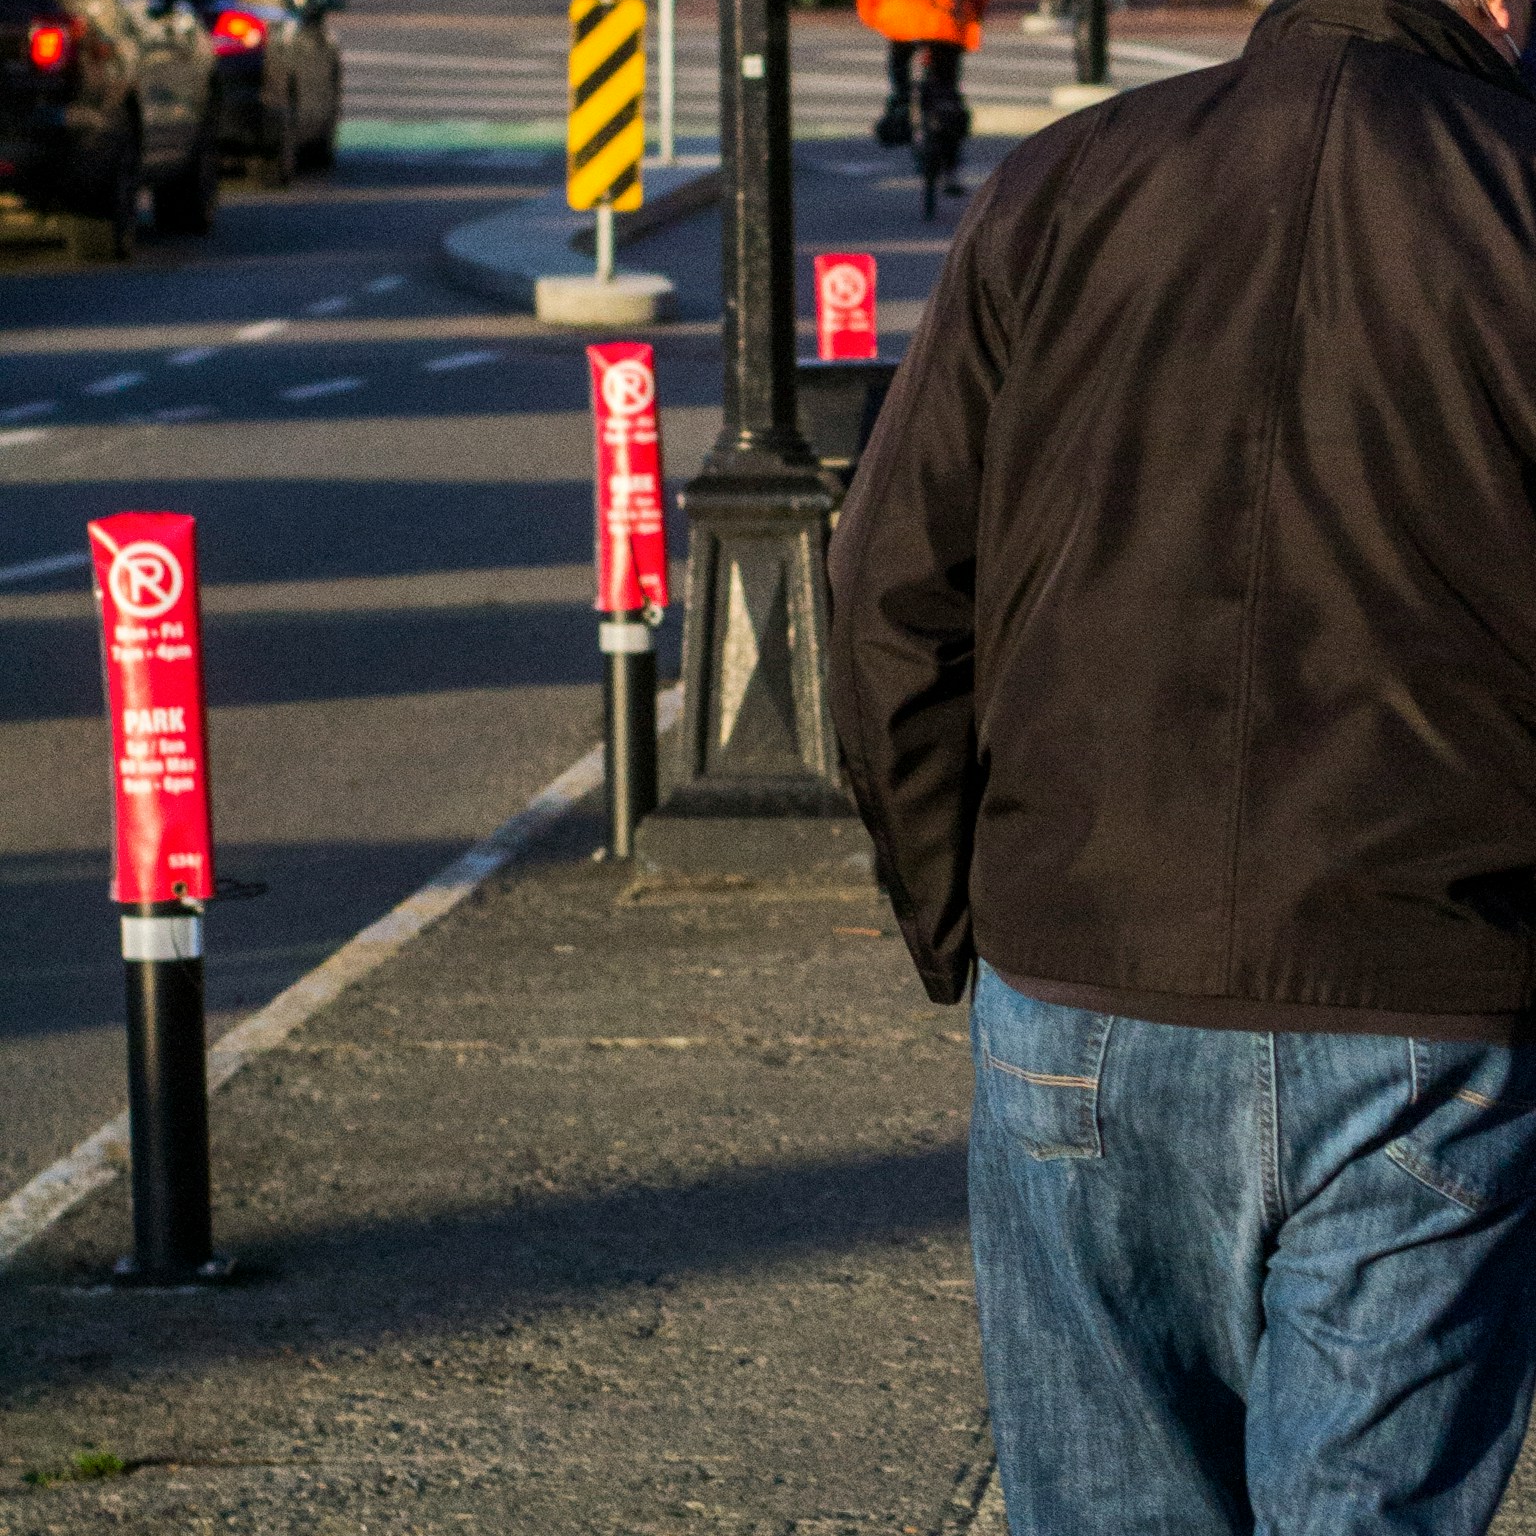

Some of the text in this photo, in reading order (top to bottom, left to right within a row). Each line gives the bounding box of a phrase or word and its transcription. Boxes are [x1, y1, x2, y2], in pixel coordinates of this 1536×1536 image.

[161, 621, 184, 639] Fri
[156, 642, 193, 663] 4pm
[124, 707, 186, 734] PARK
